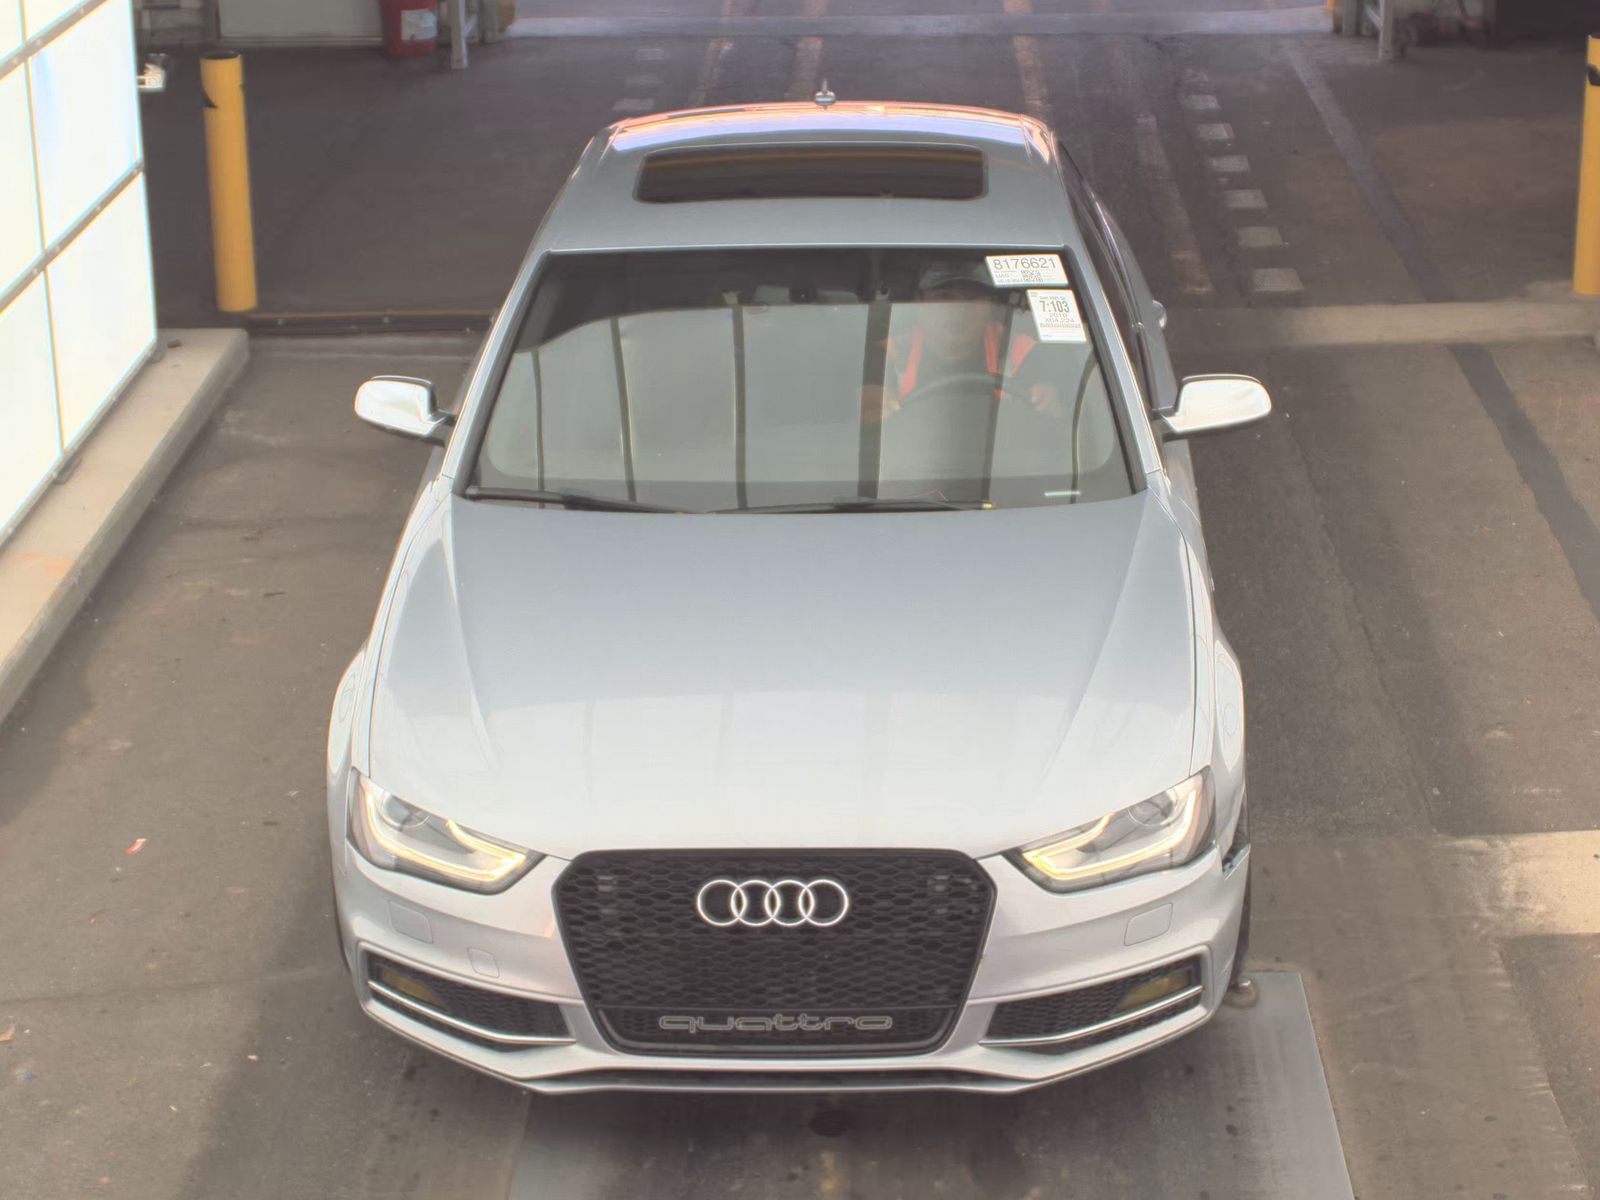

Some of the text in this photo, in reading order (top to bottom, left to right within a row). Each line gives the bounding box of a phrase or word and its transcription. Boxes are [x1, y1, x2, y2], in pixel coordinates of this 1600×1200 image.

[992, 257, 1057, 270] 8176621
[1039, 300, 1070, 313] 7:103
[658, 1013, 893, 1034] quattro
